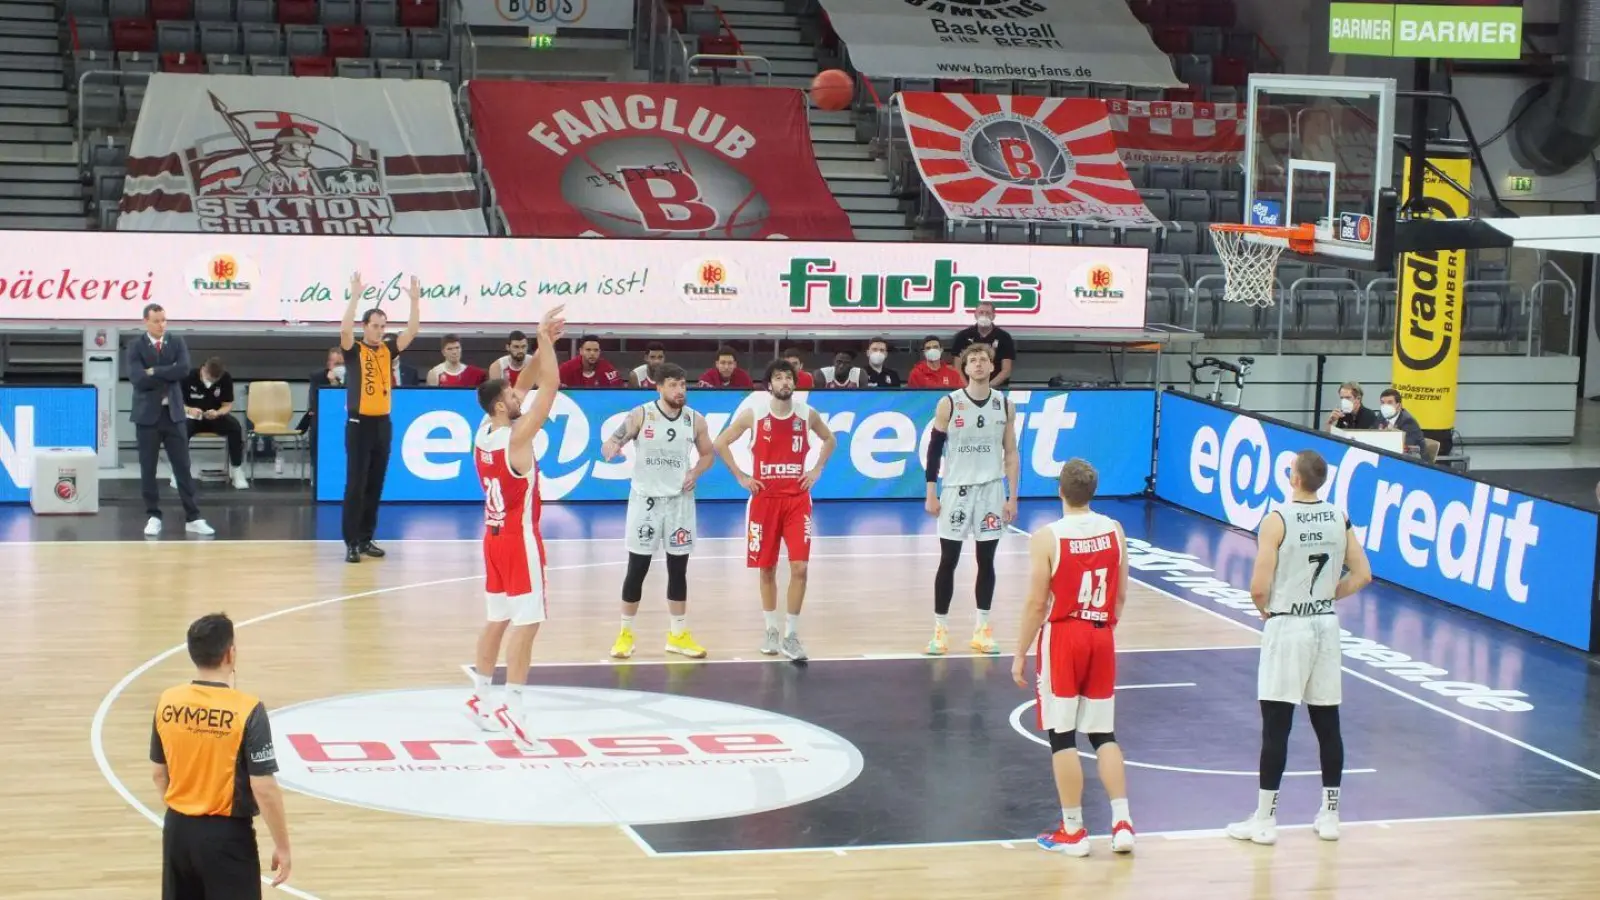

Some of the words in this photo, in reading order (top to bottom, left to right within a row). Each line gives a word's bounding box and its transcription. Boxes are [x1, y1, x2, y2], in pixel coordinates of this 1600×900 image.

[931, 18, 1056, 38] Basketball
[1332, 18, 1391, 40] BARMER
[1400, 20, 1516, 43] BARMER
[936, 62, 1092, 78] www.bamberg-fans.de
[527, 94, 756, 159] FANCLUB
[198, 200, 391, 218] SEKTION
[192, 278, 252, 290] fuchs
[480, 280, 527, 297] was
[538, 282, 587, 296] man
[598, 268, 648, 297] isst!
[683, 283, 738, 296] fuchs
[780, 257, 1041, 313] fuchs
[1073, 286, 1125, 299] fuchs
[976, 415, 985, 428] 8
[667, 428, 677, 442] 9
[792, 436, 803, 453] 31
[646, 458, 681, 468] BUSINESS
[760, 461, 802, 475] brose
[483, 477, 505, 513] 20
[1297, 511, 1336, 523] RICHTER
[1300, 530, 1322, 541] eins
[1308, 553, 1329, 597] 7
[1078, 568, 1108, 609] 43
[162, 705, 234, 728] GYMPER
[286, 733, 792, 762] brose
[307, 762, 505, 774] Excellence
[564, 757, 809, 770] Mechatronics
